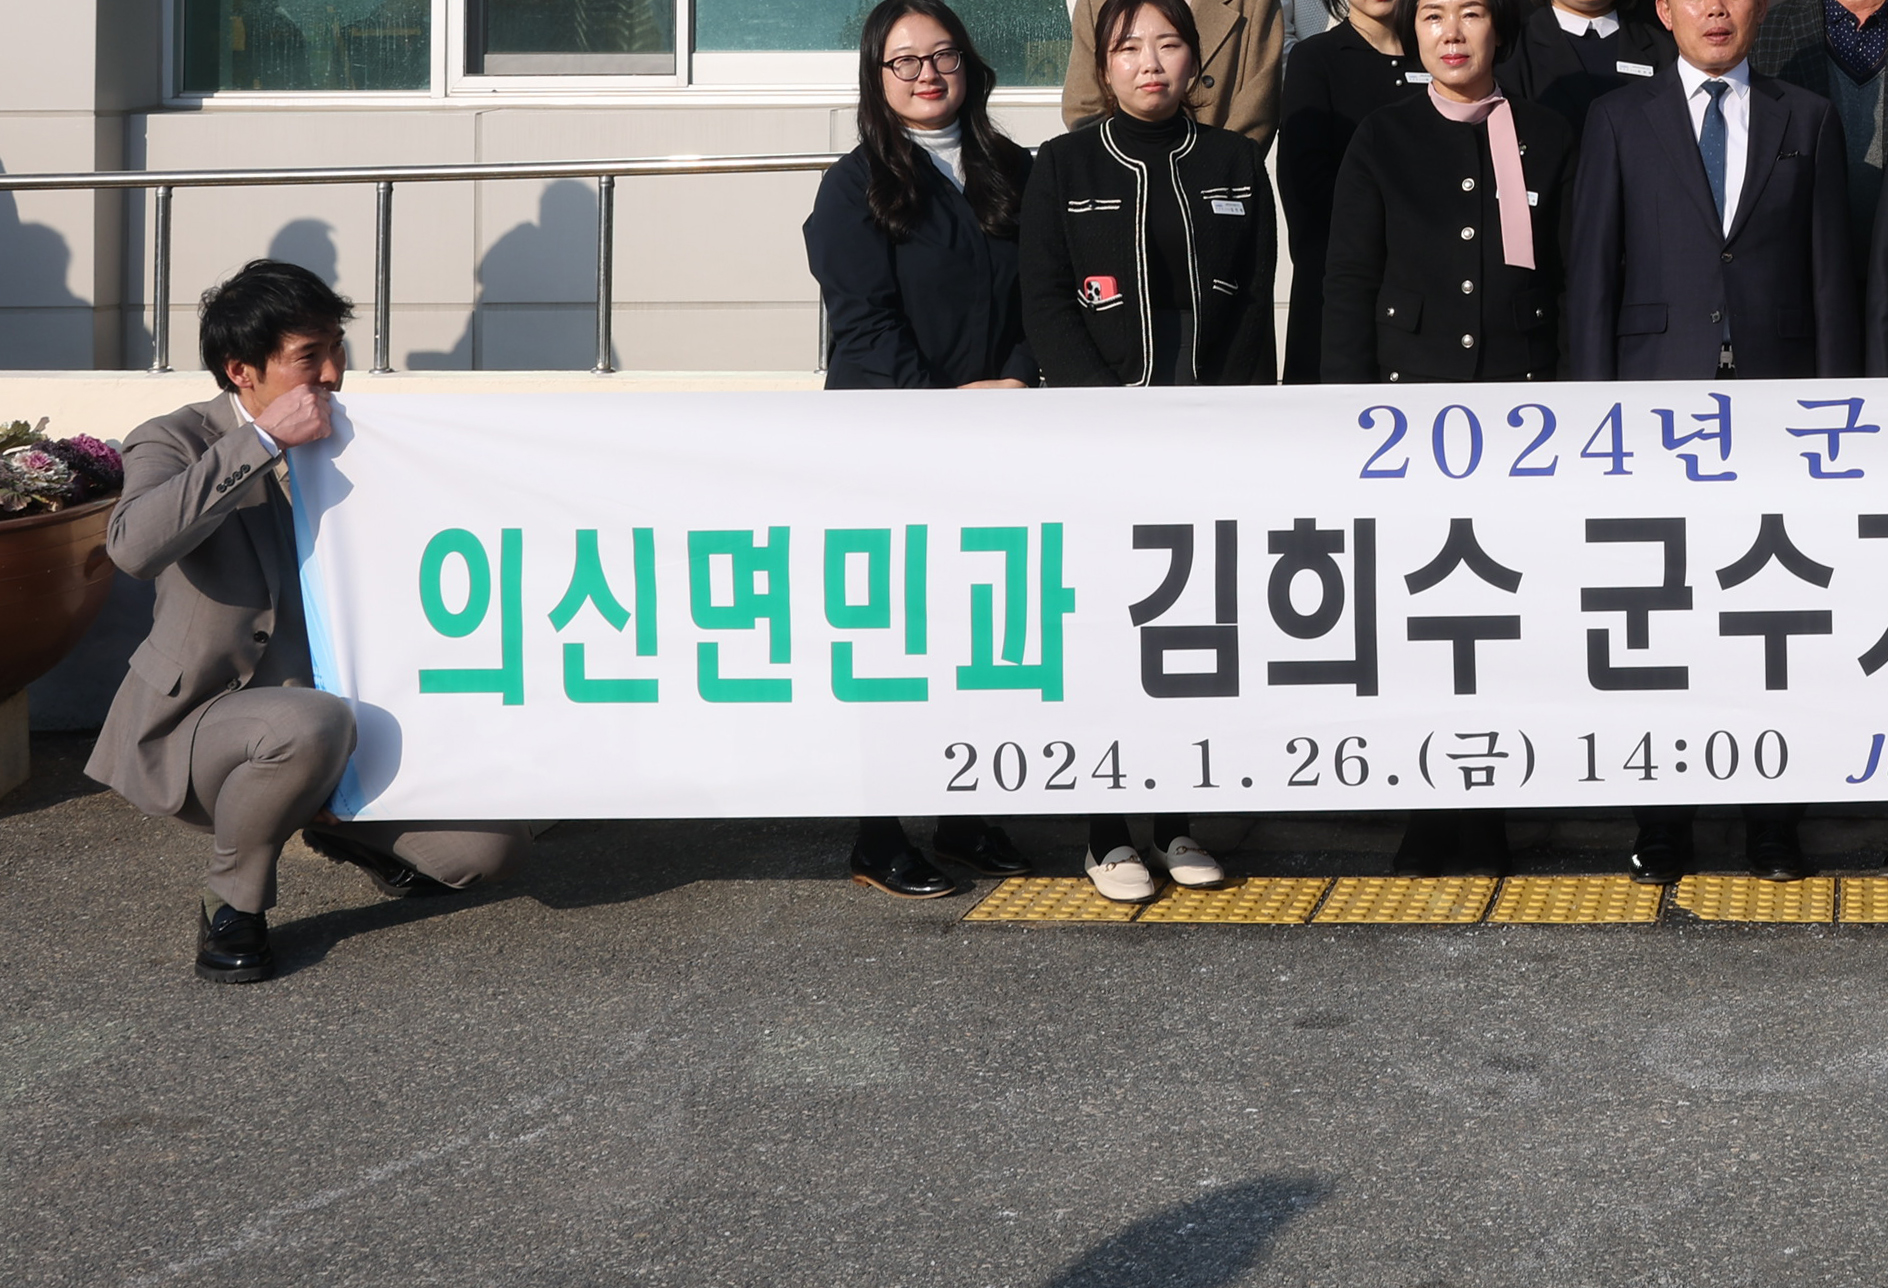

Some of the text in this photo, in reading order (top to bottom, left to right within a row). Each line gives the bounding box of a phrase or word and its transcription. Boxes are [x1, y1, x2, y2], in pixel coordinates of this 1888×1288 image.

[1357, 392, 1738, 482] 2024년
[418, 522, 1076, 706] 의신면민과
[1128, 517, 1523, 699] 김희수
[944, 740, 1156, 792] 2024.
[1192, 738, 1253, 788] 1.
[1578, 729, 1789, 782] 14:00
